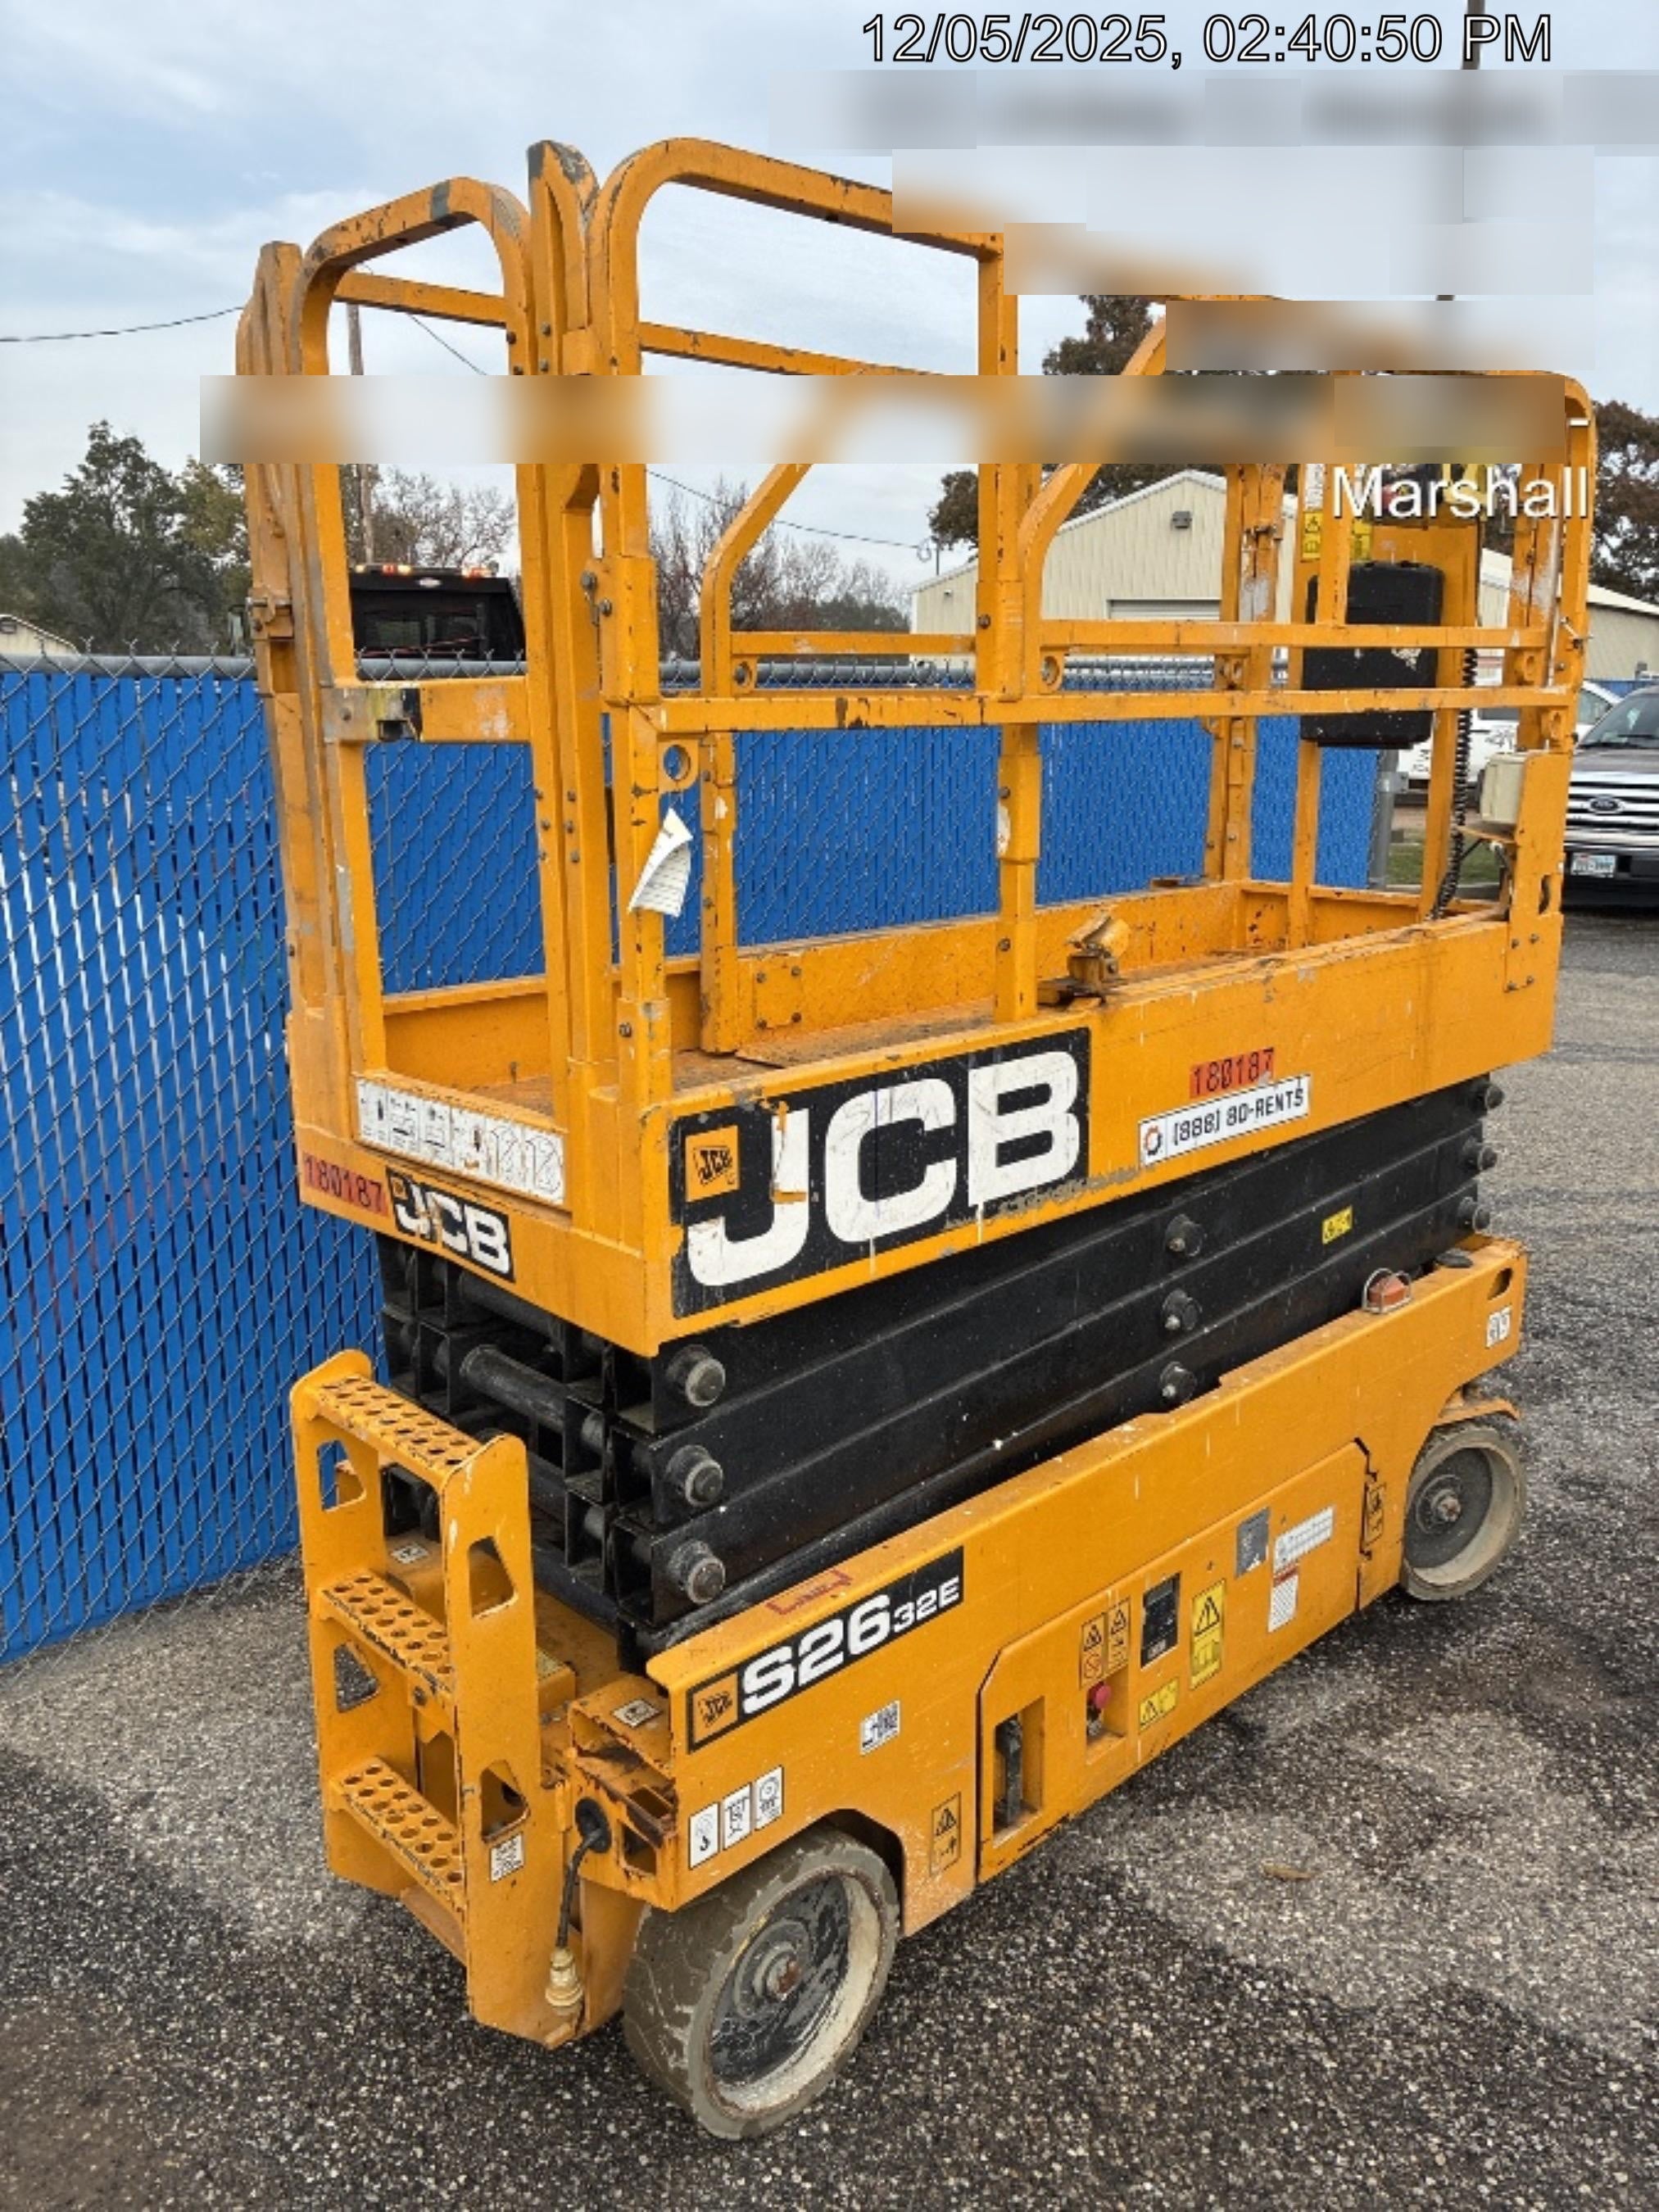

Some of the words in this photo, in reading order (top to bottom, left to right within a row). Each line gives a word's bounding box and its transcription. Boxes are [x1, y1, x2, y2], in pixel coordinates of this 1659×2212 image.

[1193, 1047, 1275, 1095] 180187
[1173, 1108, 1221, 1145] (888)
[304, 1154, 383, 1214] 180187
[687, 1050, 1081, 1286] JCB
[395, 1183, 511, 1275] JCB
